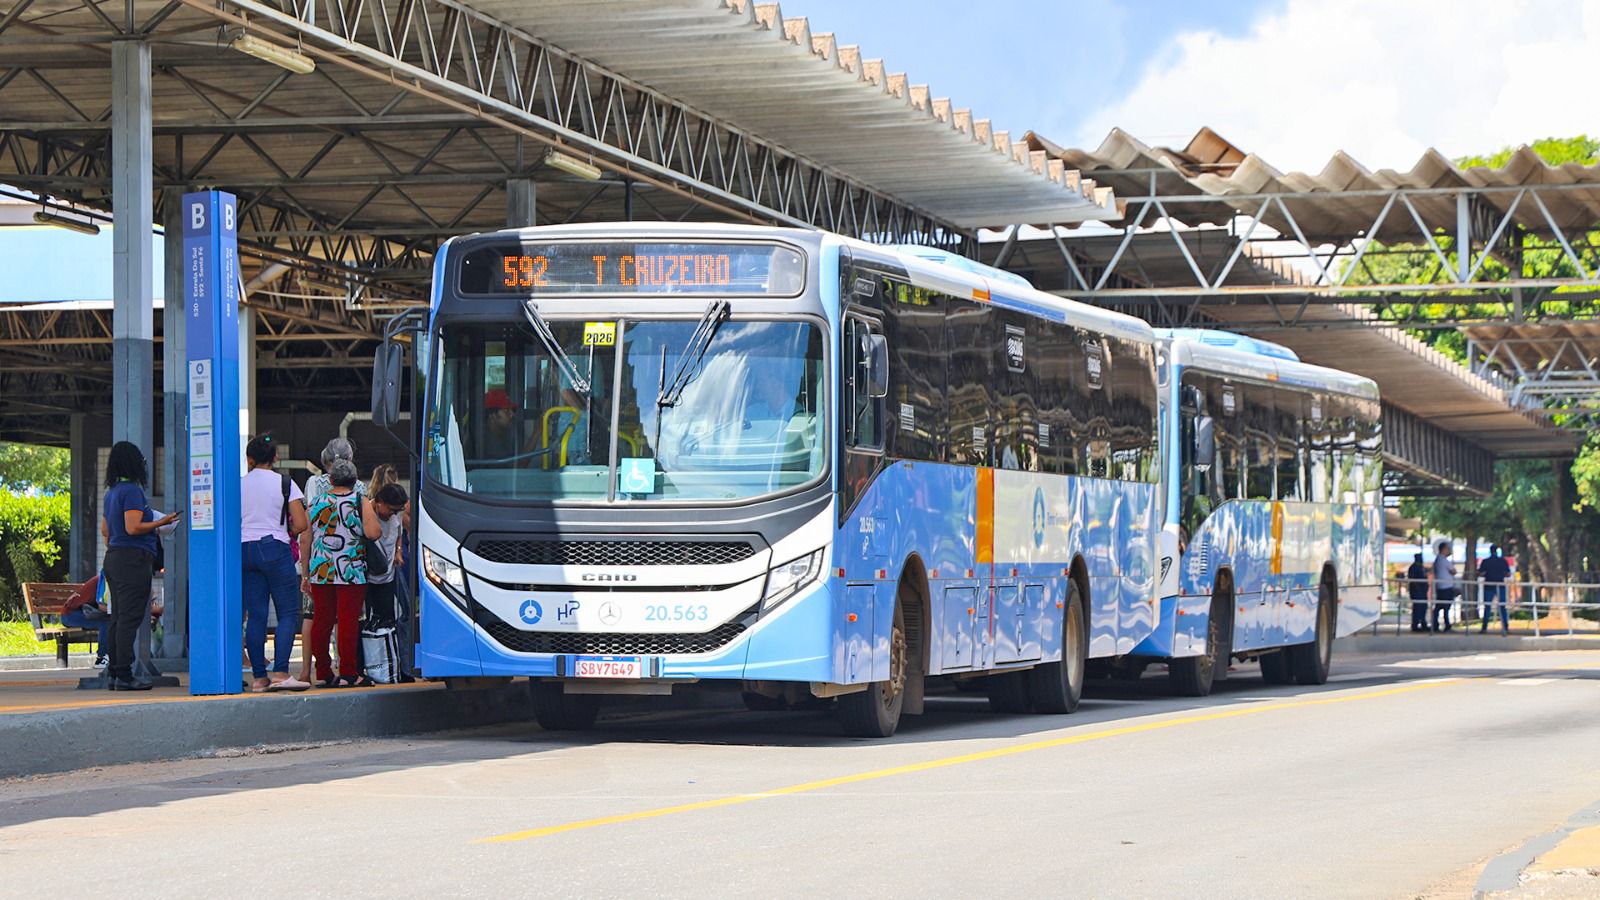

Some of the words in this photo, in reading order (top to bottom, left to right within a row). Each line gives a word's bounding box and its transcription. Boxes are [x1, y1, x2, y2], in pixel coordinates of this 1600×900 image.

[191, 203, 205, 230] B
[225, 203, 234, 231] B
[504, 255, 549, 287] 592
[592, 255, 607, 286] T
[619, 255, 730, 286] CRUZEIRO
[586, 333, 612, 343] 2026
[582, 573, 637, 582] CAIO
[557, 600, 581, 621] HP
[644, 604, 709, 622] 20.563
[581, 662, 634, 676] SBY7G49
